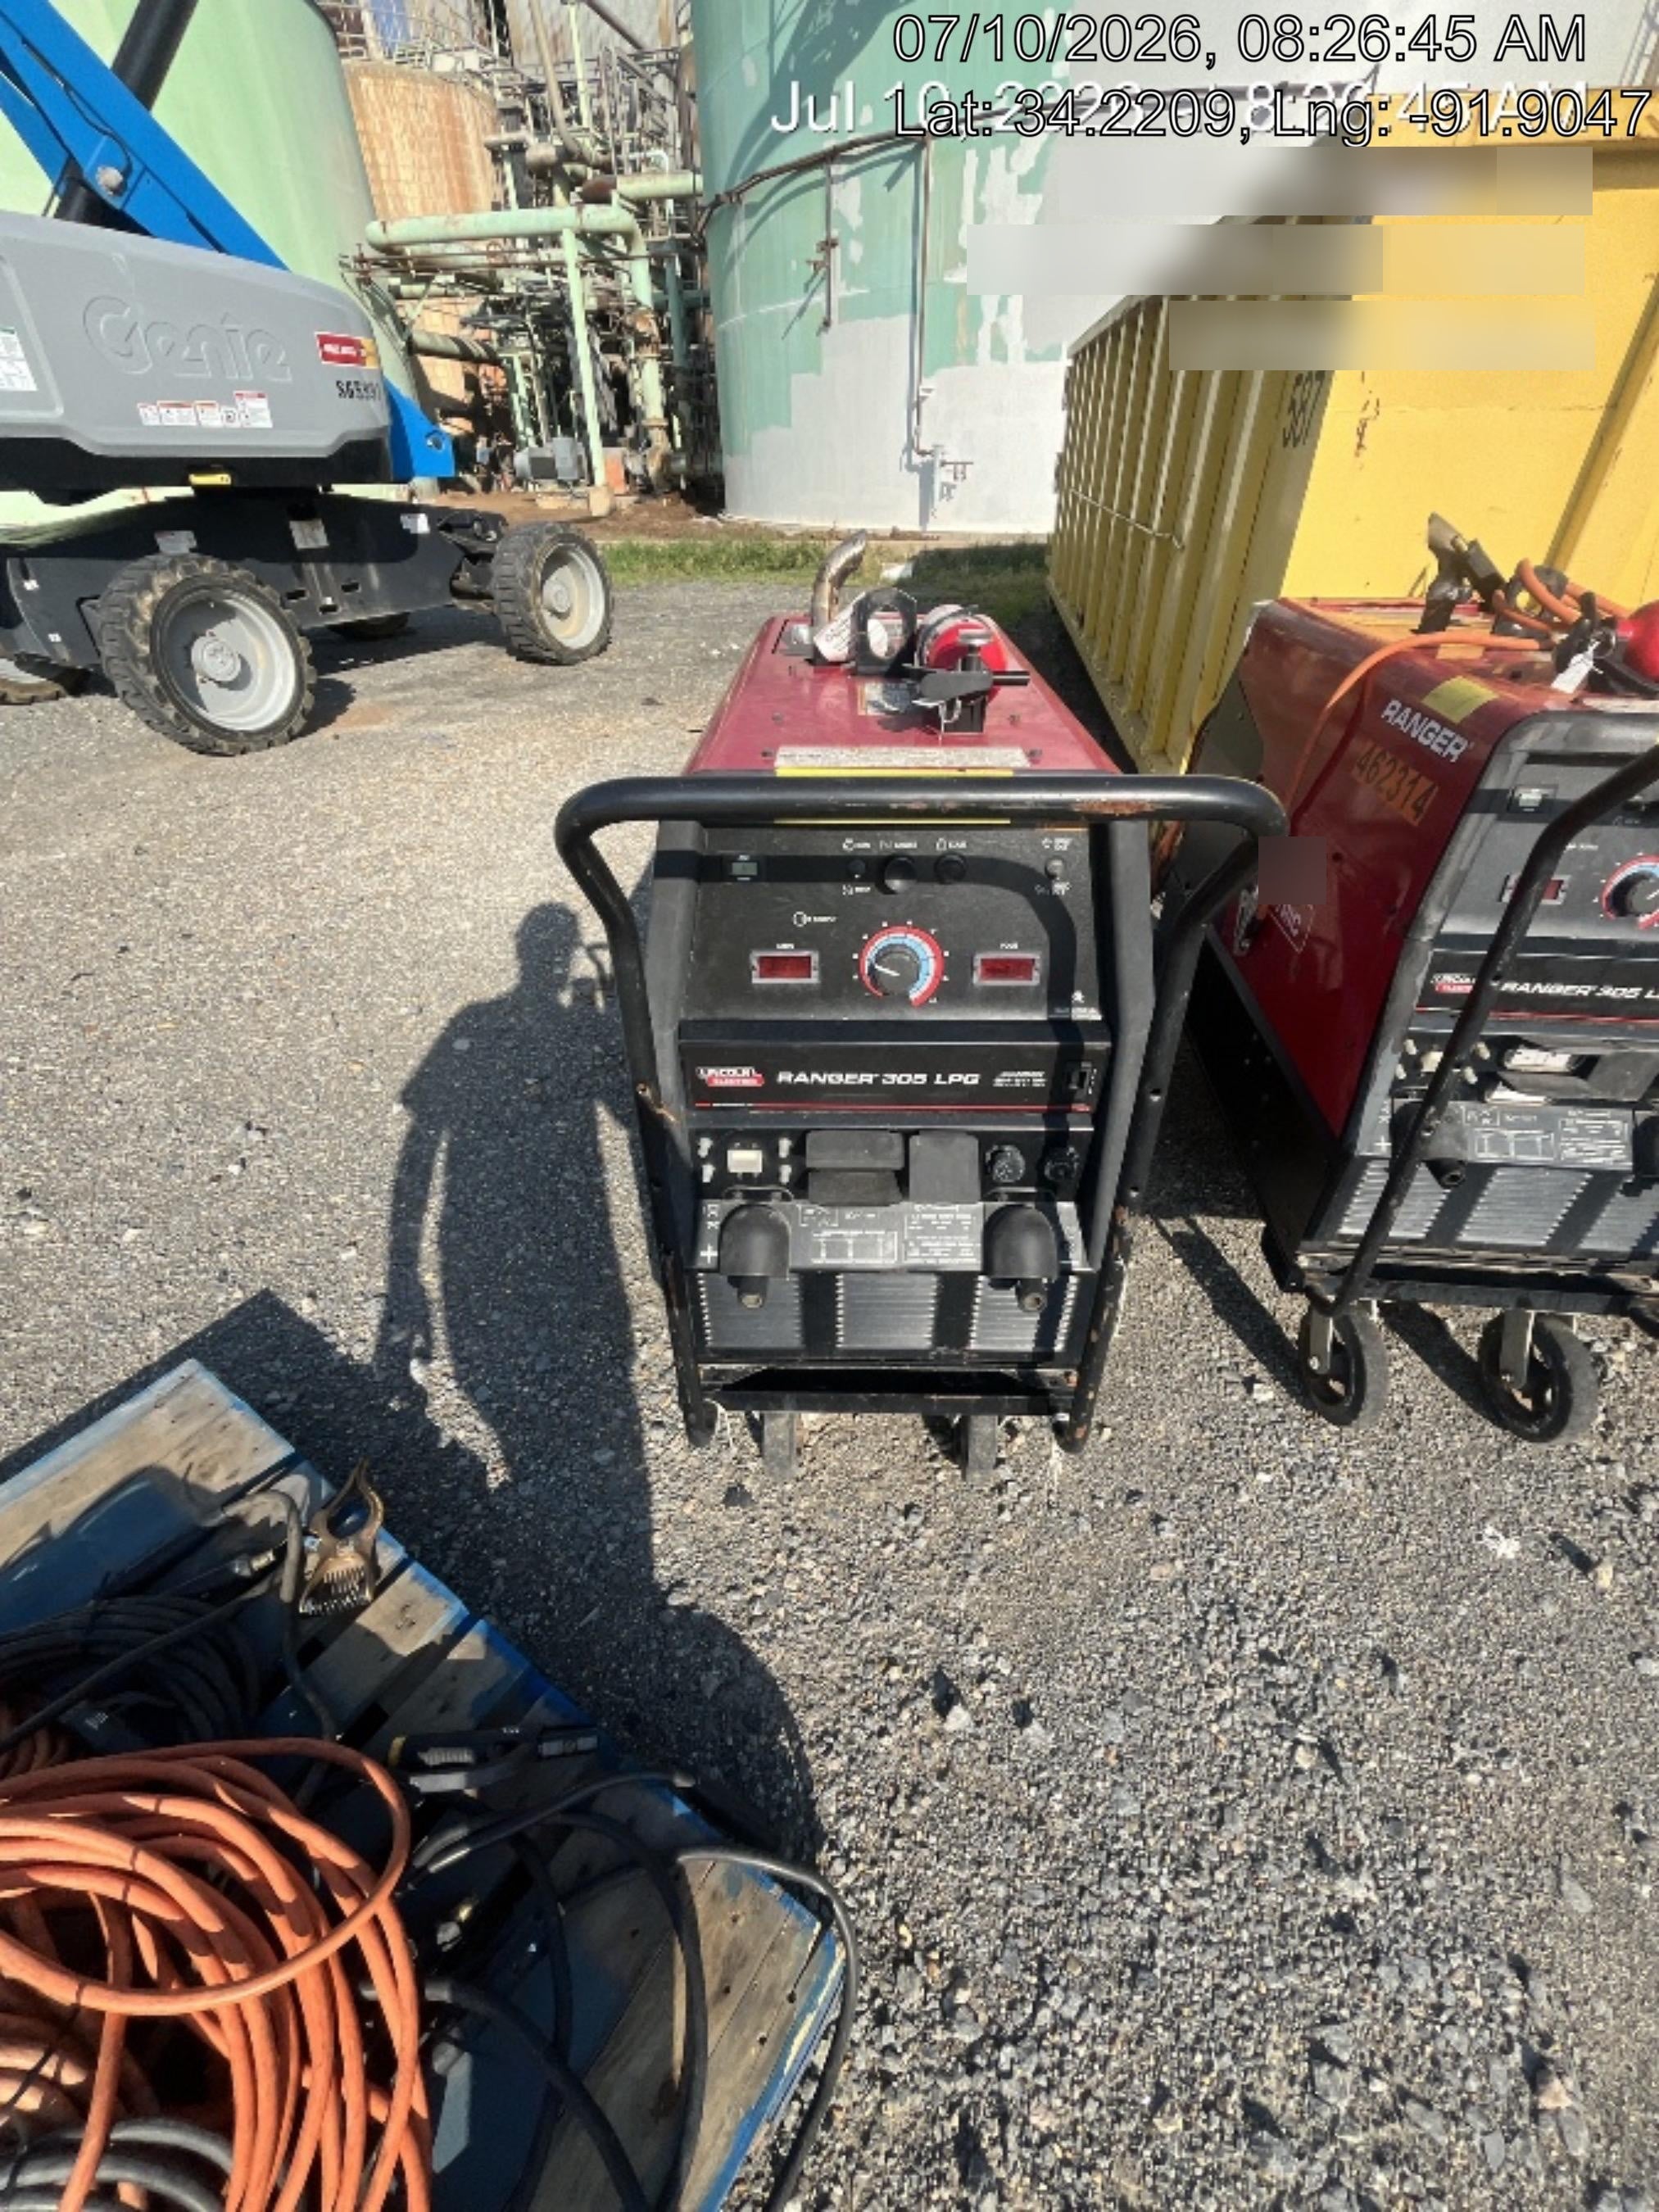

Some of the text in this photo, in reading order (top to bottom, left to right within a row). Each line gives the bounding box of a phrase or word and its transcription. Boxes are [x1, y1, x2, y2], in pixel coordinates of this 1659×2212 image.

[83, 295, 292, 383] Genie
[1380, 699, 1470, 763] RANGER
[1499, 981, 1590, 996] RANGER
[1595, 986, 1643, 999] 305
[777, 1071, 875, 1085] RANGER
[882, 1072, 927, 1085] 305
[934, 1072, 981, 1085] LPG
